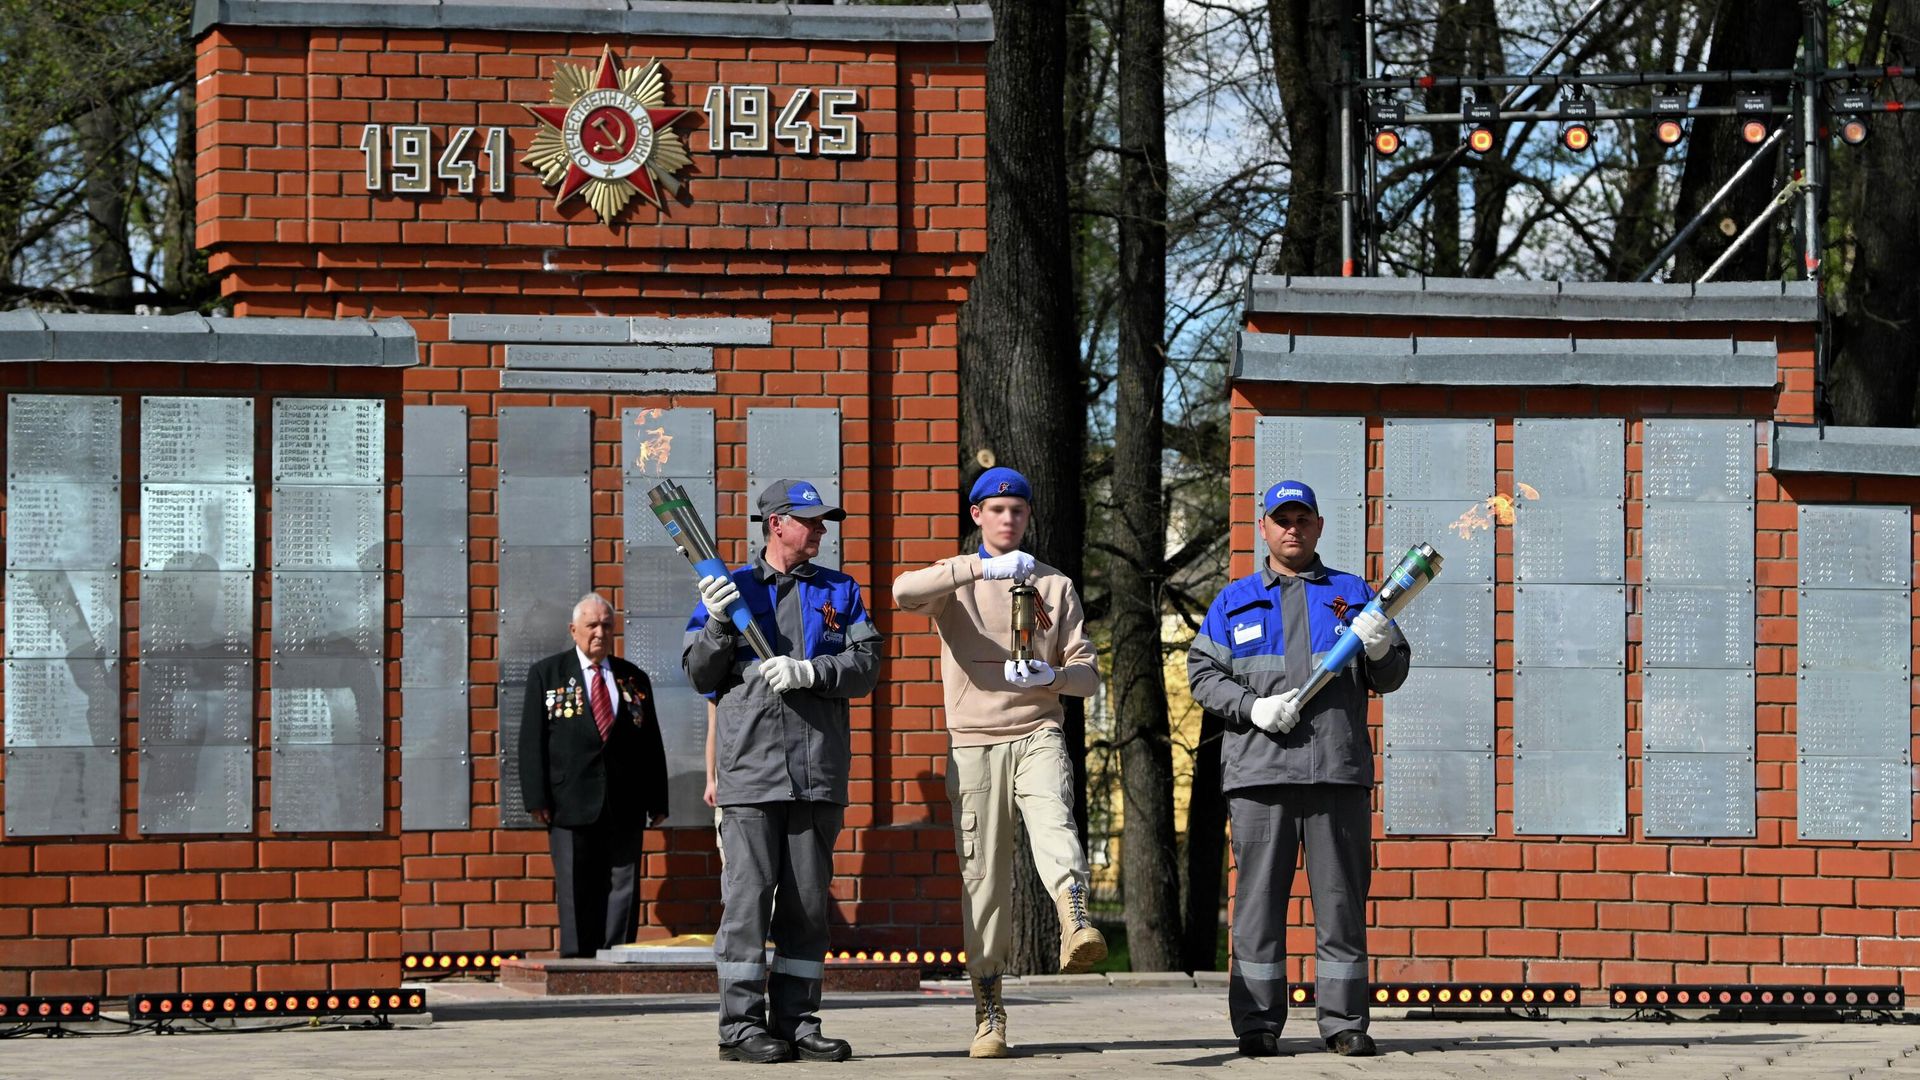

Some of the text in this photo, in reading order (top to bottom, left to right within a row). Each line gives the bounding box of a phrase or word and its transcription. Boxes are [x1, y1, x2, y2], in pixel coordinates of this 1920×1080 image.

[566, 90, 638, 168] ОТЕЧЕСТВЕННАЯ
[703, 86, 857, 154] 1945
[360, 124, 505, 192] 1941
